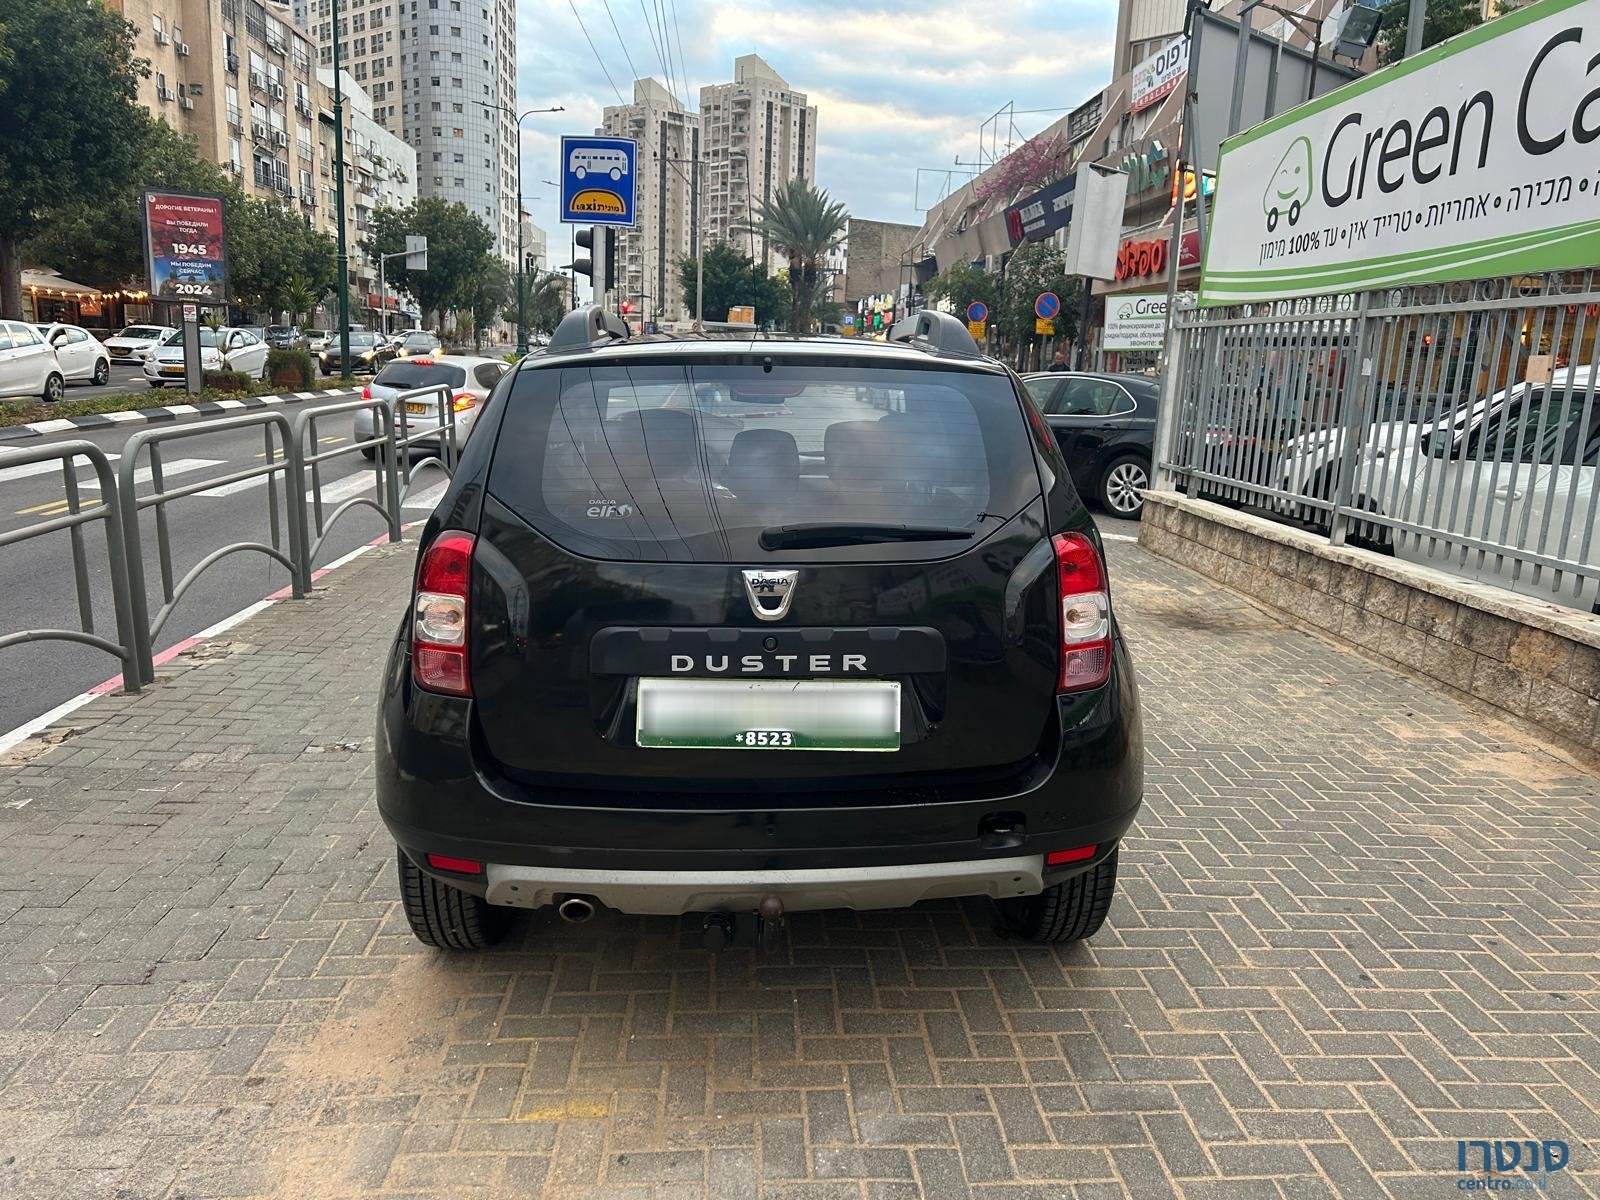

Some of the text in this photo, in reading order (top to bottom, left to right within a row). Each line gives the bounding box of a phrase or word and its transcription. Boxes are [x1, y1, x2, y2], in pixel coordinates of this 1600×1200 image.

[1321, 90, 1494, 208] Green
[1506, 175, 1572, 212] מכירה
[155, 204, 182, 212] ДОРОГИЕ
[597, 203, 620, 212] מונית
[1425, 193, 1490, 228] אחריות
[176, 220, 209, 228] ПОБЕДИЛИ
[1373, 210, 1411, 237] טרייד
[1288, 230, 1320, 255] 100%
[1323, 227, 1339, 248] עד
[1348, 219, 1368, 249] אין
[172, 243, 207, 255] 1945
[1259, 238, 1286, 266] מימון
[175, 284, 213, 295] 2024
[1135, 299, 1167, 314] Gree
[586, 505, 616, 518] elf
[751, 577, 789, 586] DACIA
[671, 654, 868, 672] DUSTER
